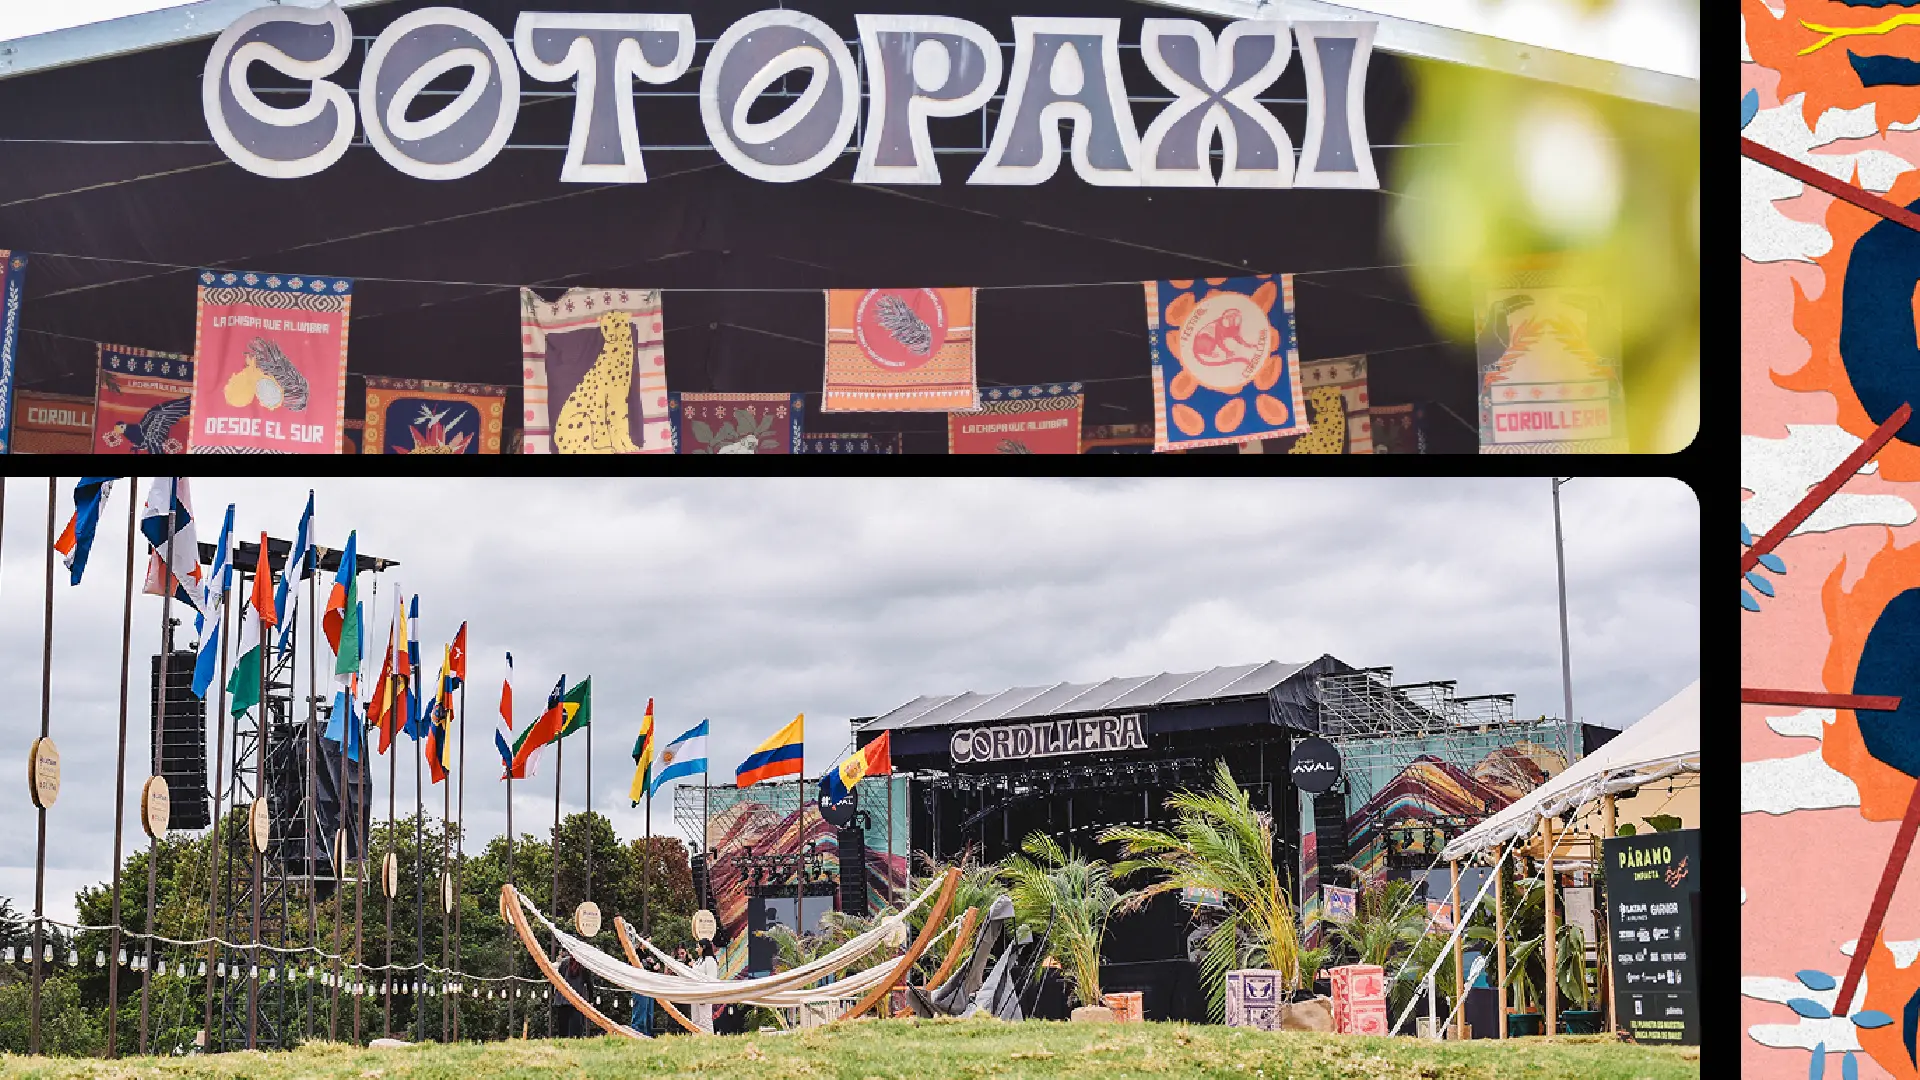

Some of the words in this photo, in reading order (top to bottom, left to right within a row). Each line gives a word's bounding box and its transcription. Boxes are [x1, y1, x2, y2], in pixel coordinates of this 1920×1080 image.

[203, 1, 1380, 190] COTOPAXI
[213, 316, 226, 328] LA
[227, 315, 262, 329] CHISPA
[263, 318, 282, 331] QUE
[284, 320, 330, 335] ALUMBRA
[27, 407, 94, 428] CORDILL
[962, 424, 975, 434] LA
[976, 423, 1008, 433] CHISPA
[1008, 421, 1026, 432] QUE
[1027, 418, 1069, 430] ALUMBRA
[1495, 407, 1608, 432] CORDILLERA
[205, 417, 262, 436] DESDE
[265, 420, 286, 440] EL
[290, 423, 324, 443] SUR
[951, 713, 1148, 763] CORDILLERA
[1292, 761, 1335, 774] AVAL
[1618, 846, 1671, 868] PÁRAMO
